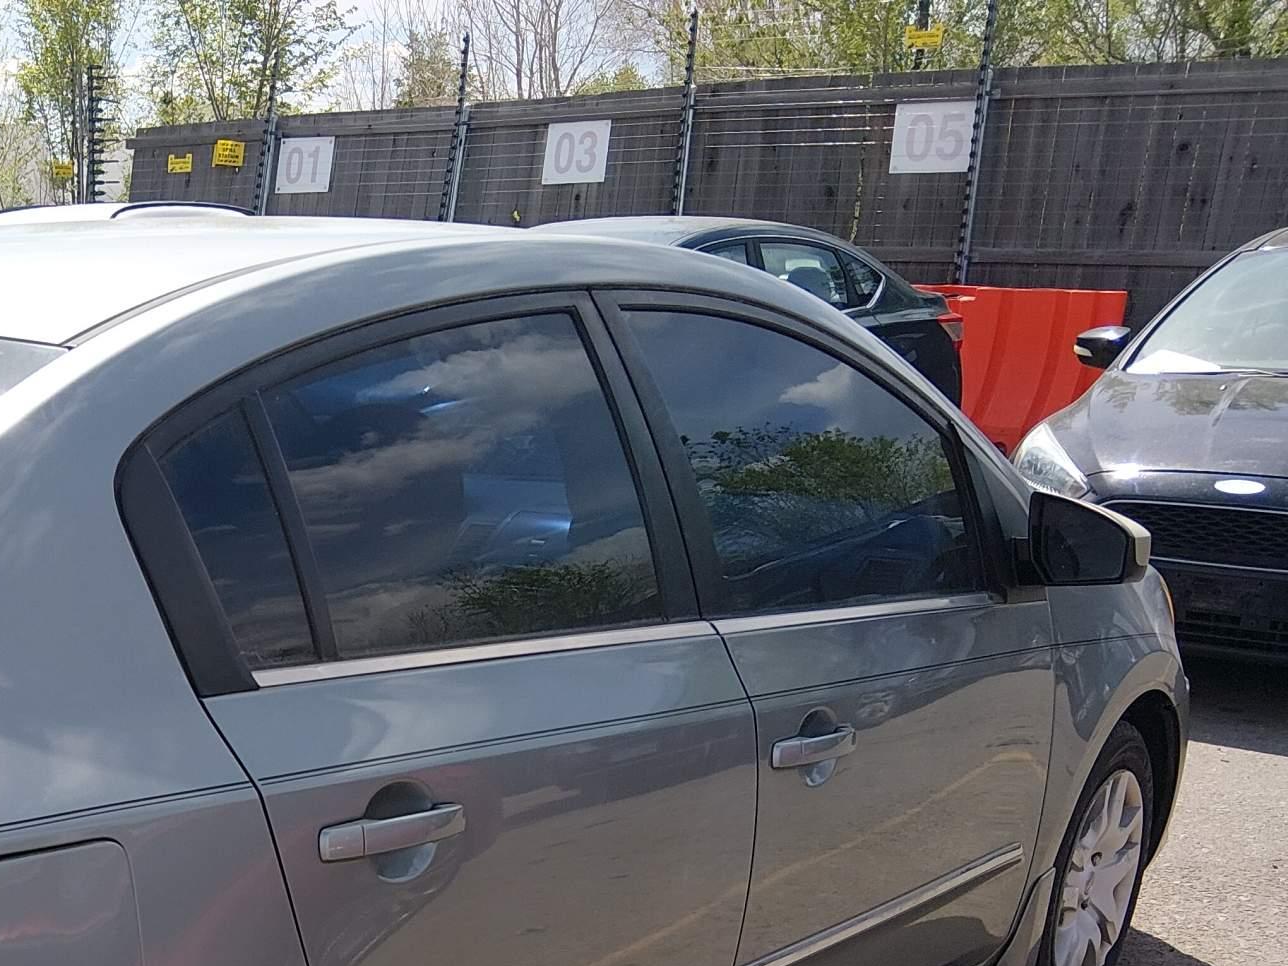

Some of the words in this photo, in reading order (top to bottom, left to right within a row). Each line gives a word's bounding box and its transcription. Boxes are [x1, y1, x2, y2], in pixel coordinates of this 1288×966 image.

[554, 131, 598, 174] 03
[905, 113, 966, 162] 05
[286, 146, 321, 185] 01
